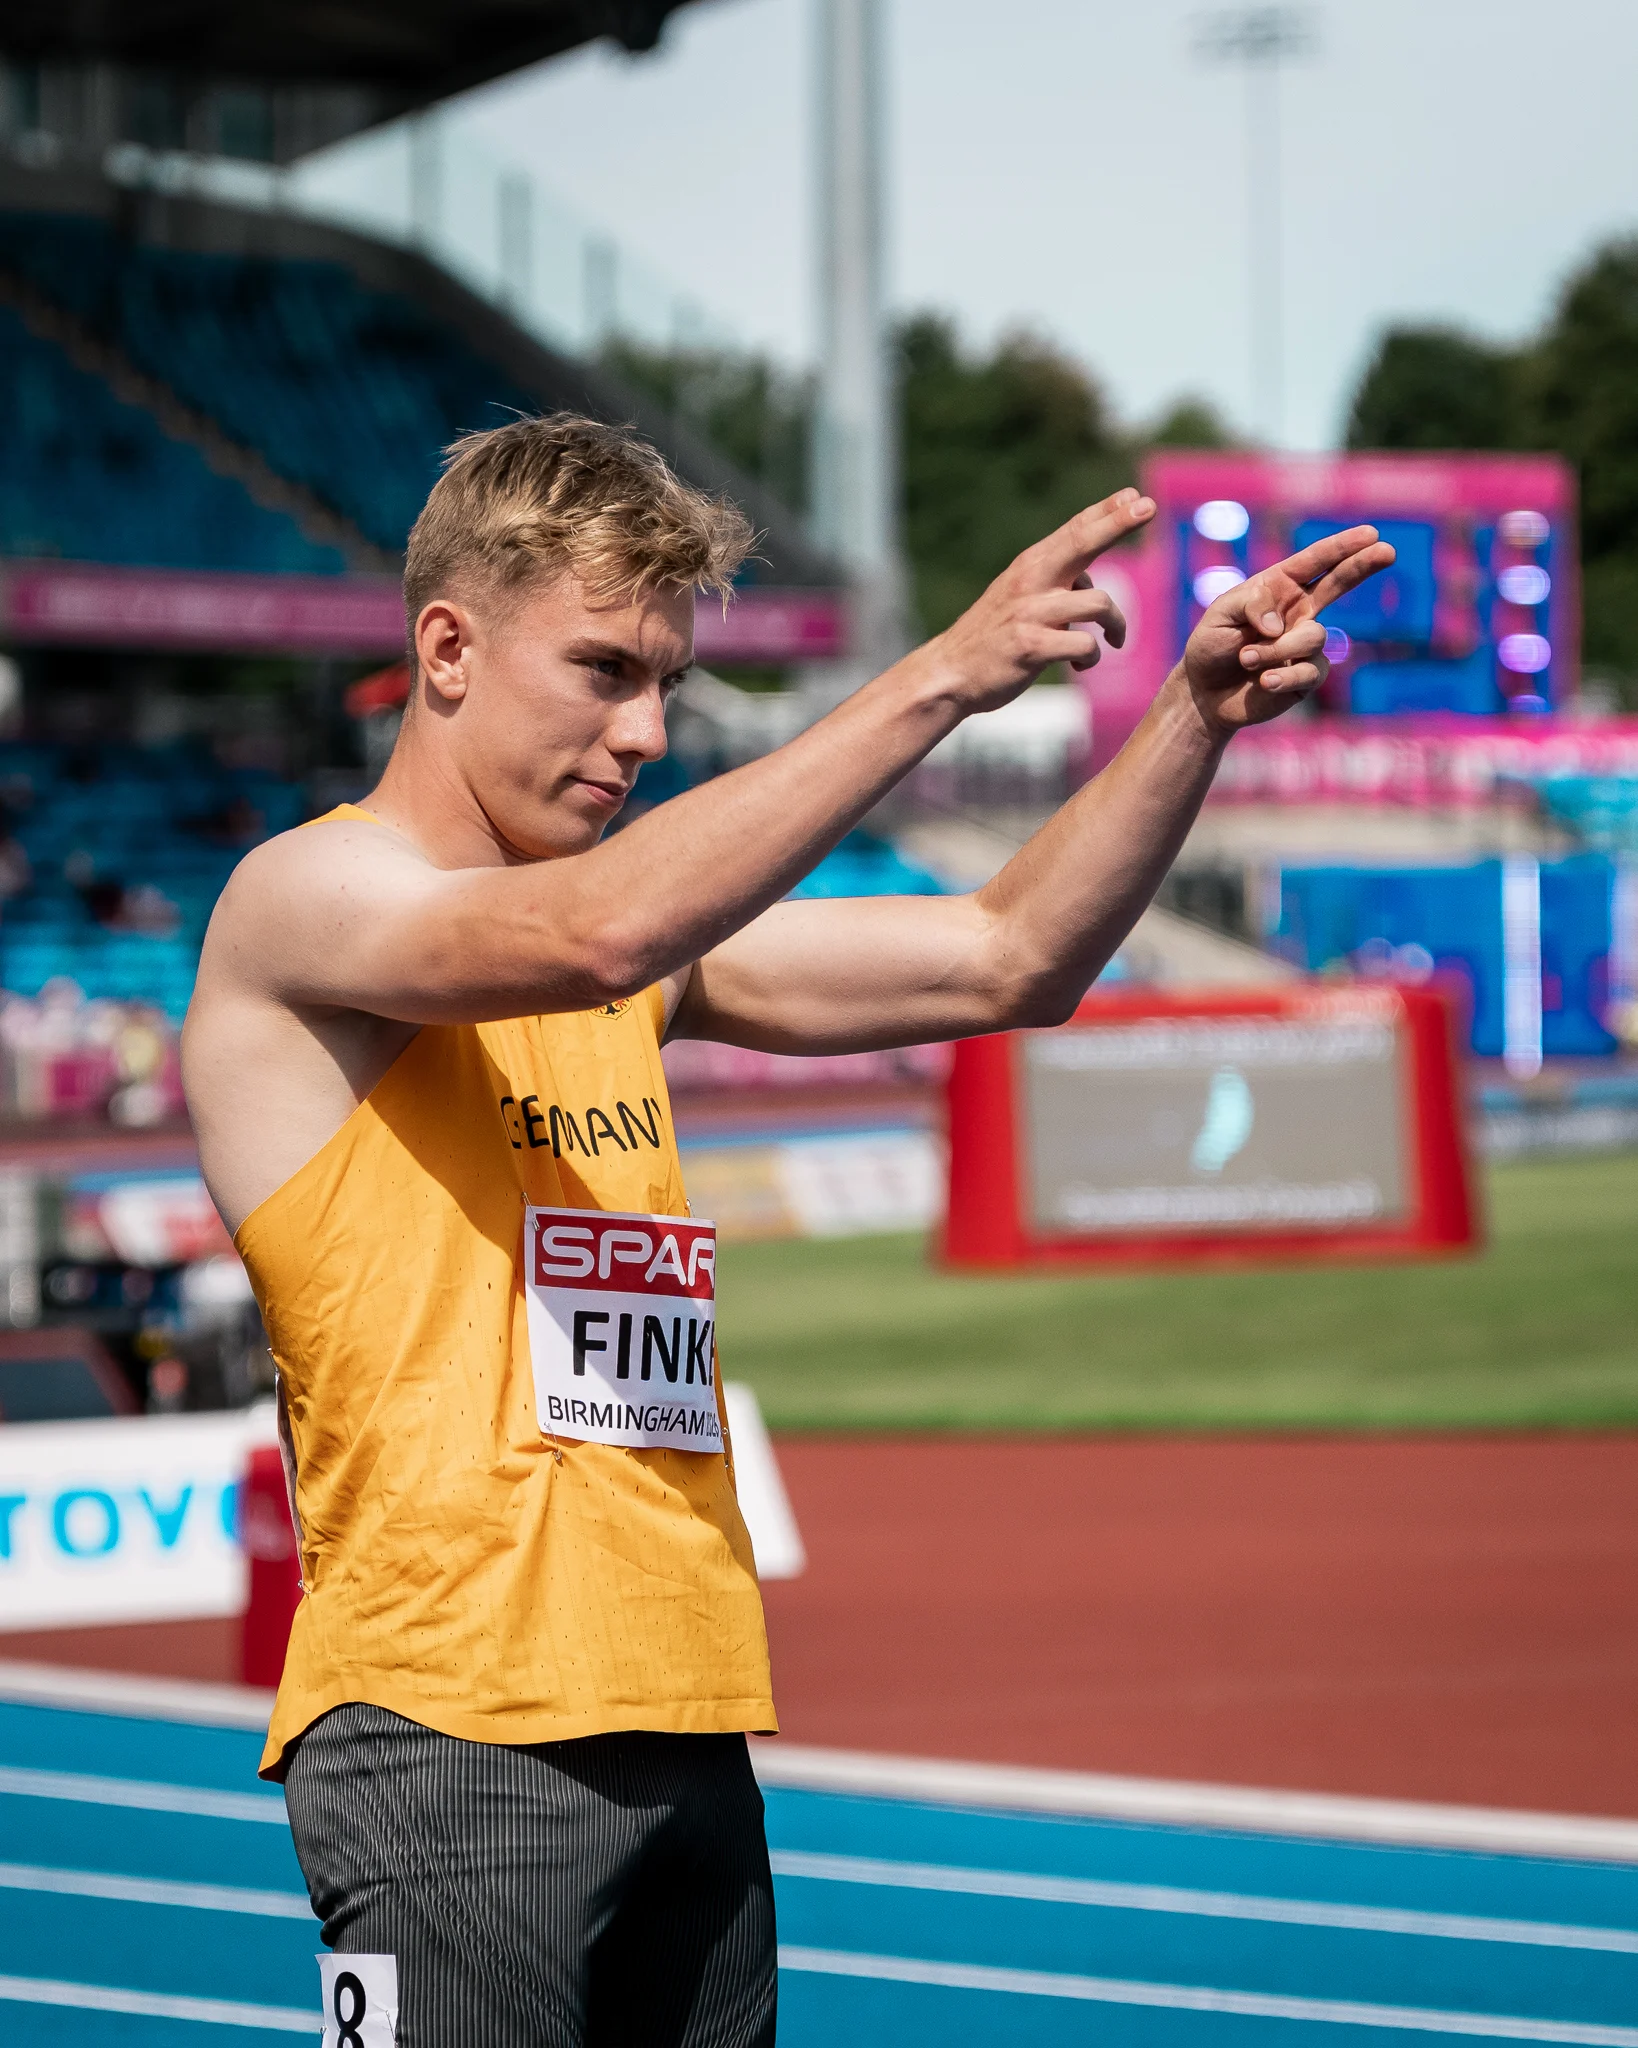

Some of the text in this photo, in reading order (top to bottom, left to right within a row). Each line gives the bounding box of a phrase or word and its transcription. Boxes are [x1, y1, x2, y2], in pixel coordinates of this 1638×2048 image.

[541, 1225, 716, 1288] SPAR
[548, 1395, 705, 1436] BIRMINGHAM
[333, 1971, 366, 2048] 8
